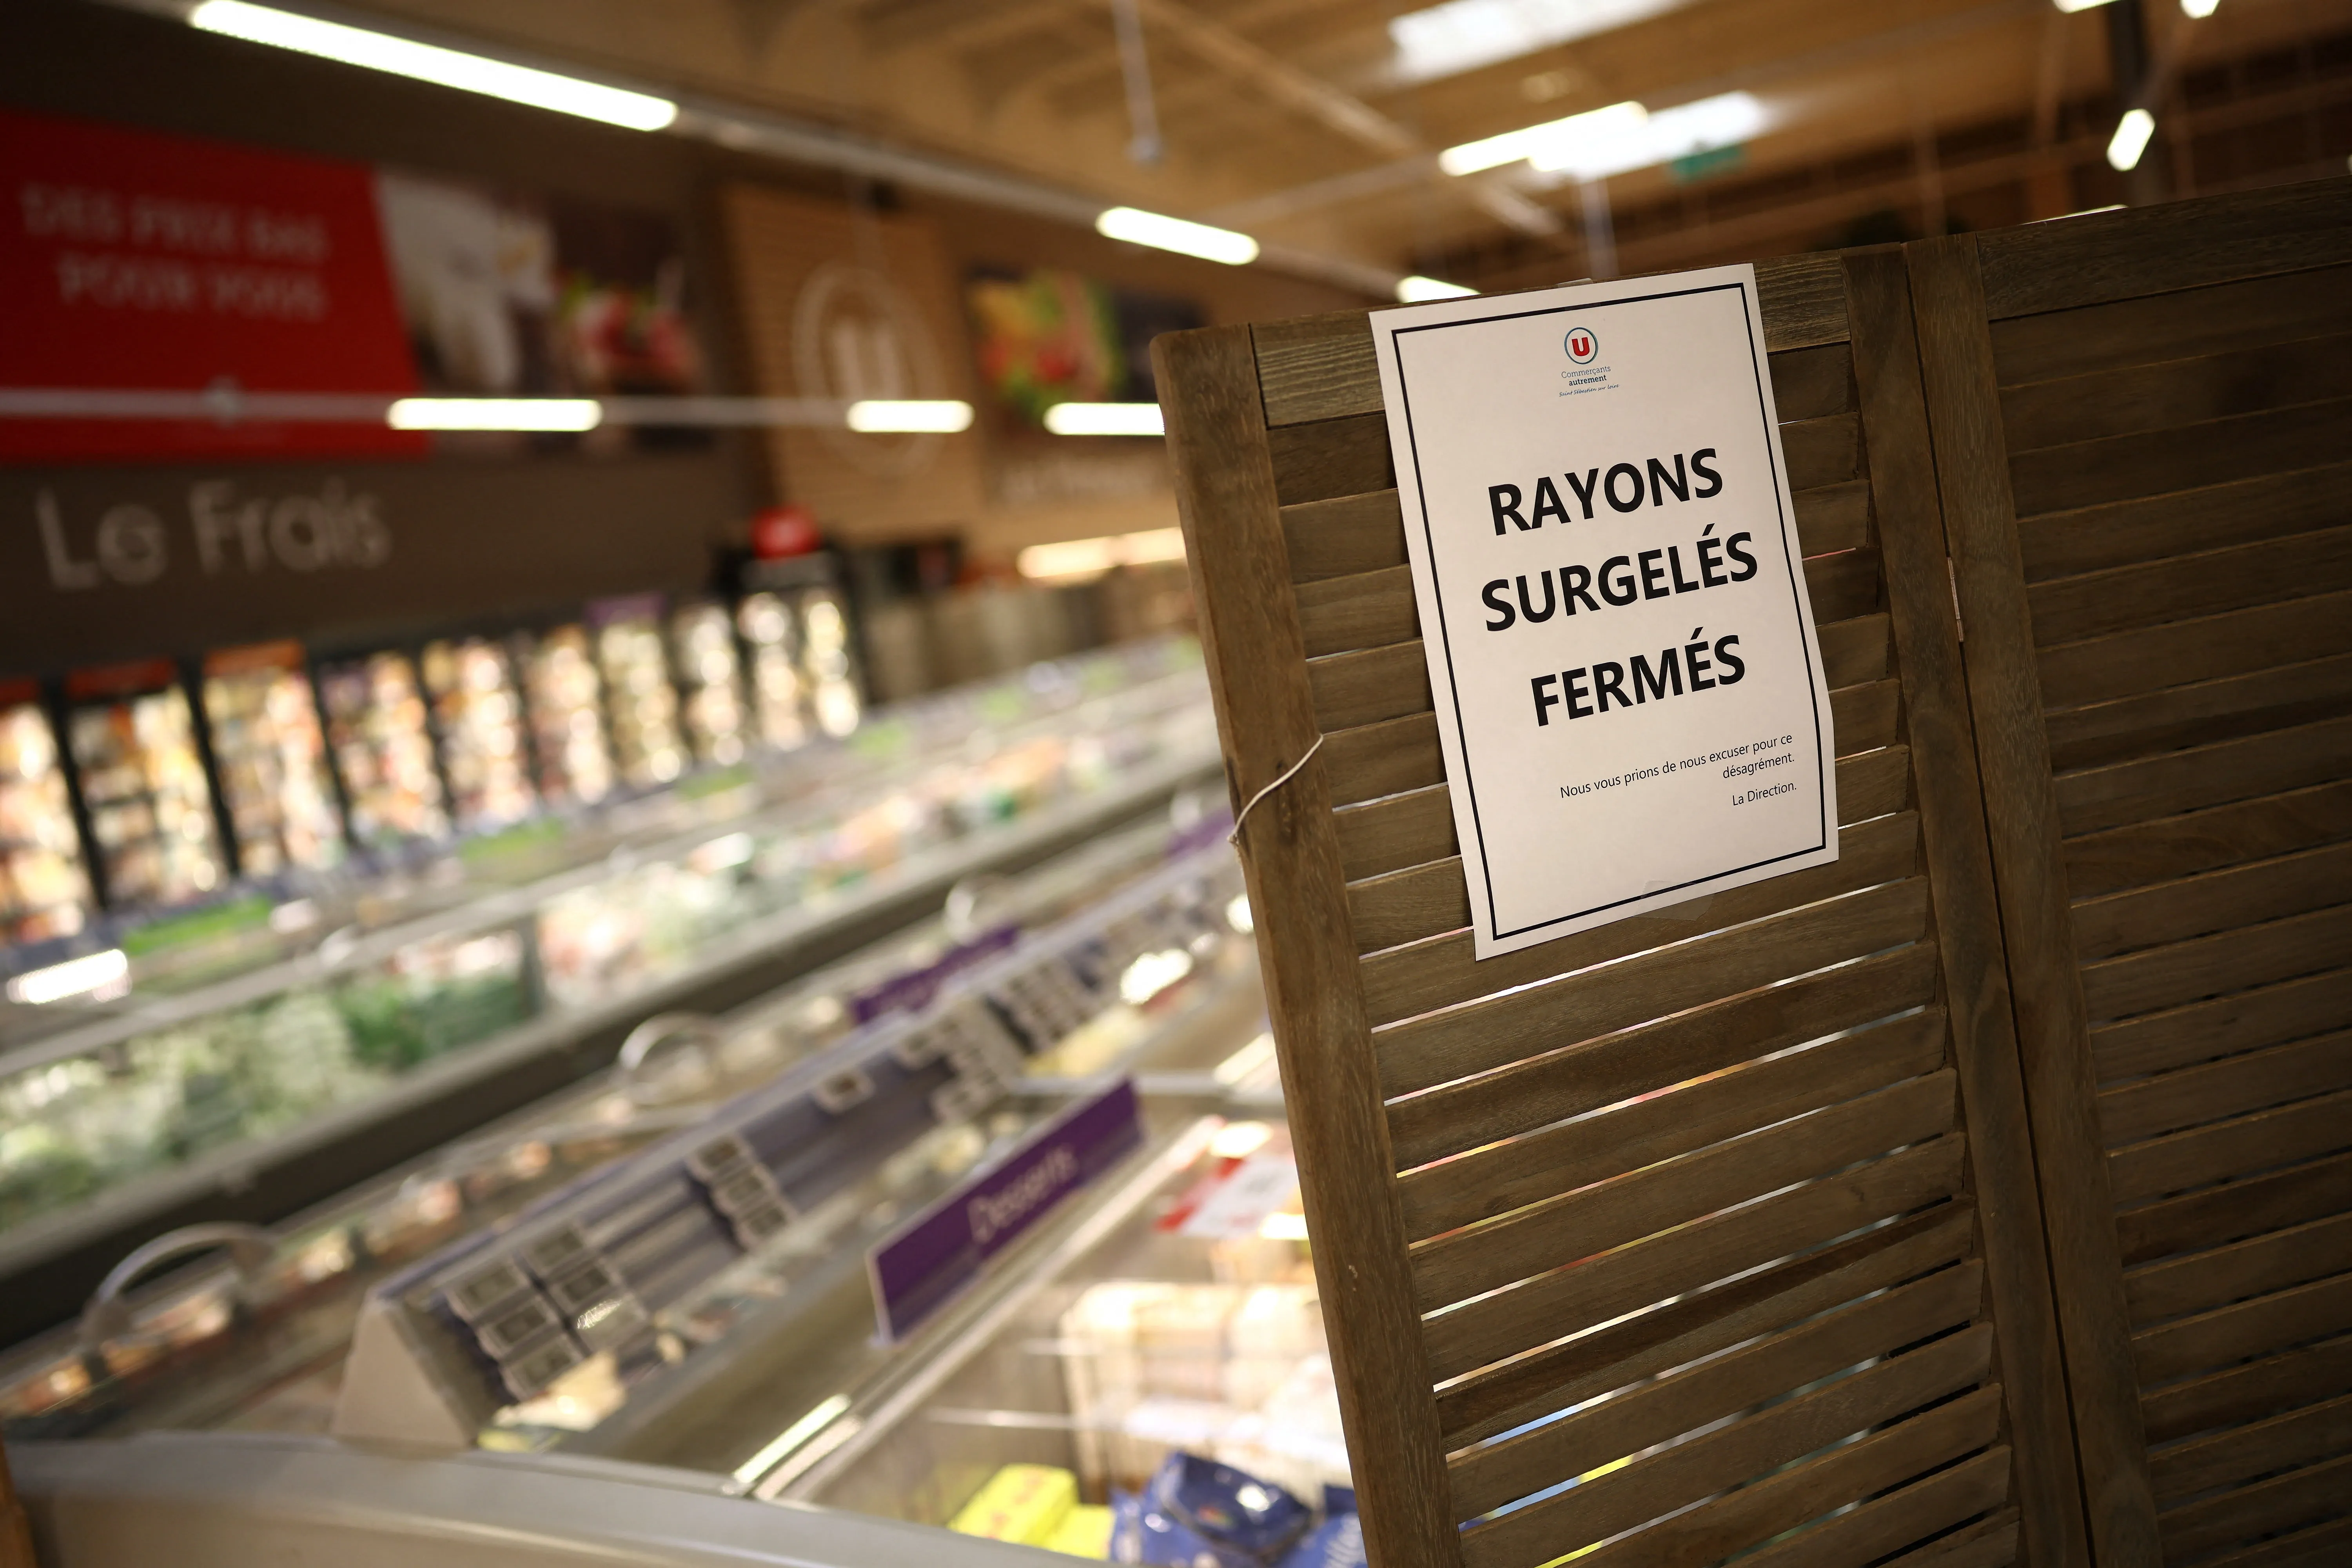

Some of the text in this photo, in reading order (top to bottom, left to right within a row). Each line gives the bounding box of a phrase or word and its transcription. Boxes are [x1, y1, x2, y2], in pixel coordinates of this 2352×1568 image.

[1572, 336, 1590, 356] U
[1561, 366, 1611, 378] Commerçants
[1569, 375, 1607, 386] autrement
[1488, 448, 1723, 536] RAYONS
[36, 475, 392, 591] Le Frais
[1482, 523, 1757, 632] SURGELÉS
[1531, 626, 1745, 727] FERMÉS
[1560, 735, 1792, 799] Nous vous prions de nous excuser pour ce
[1723, 752, 1795, 779] désagrément.
[1732, 783, 1797, 806] La Direction.
